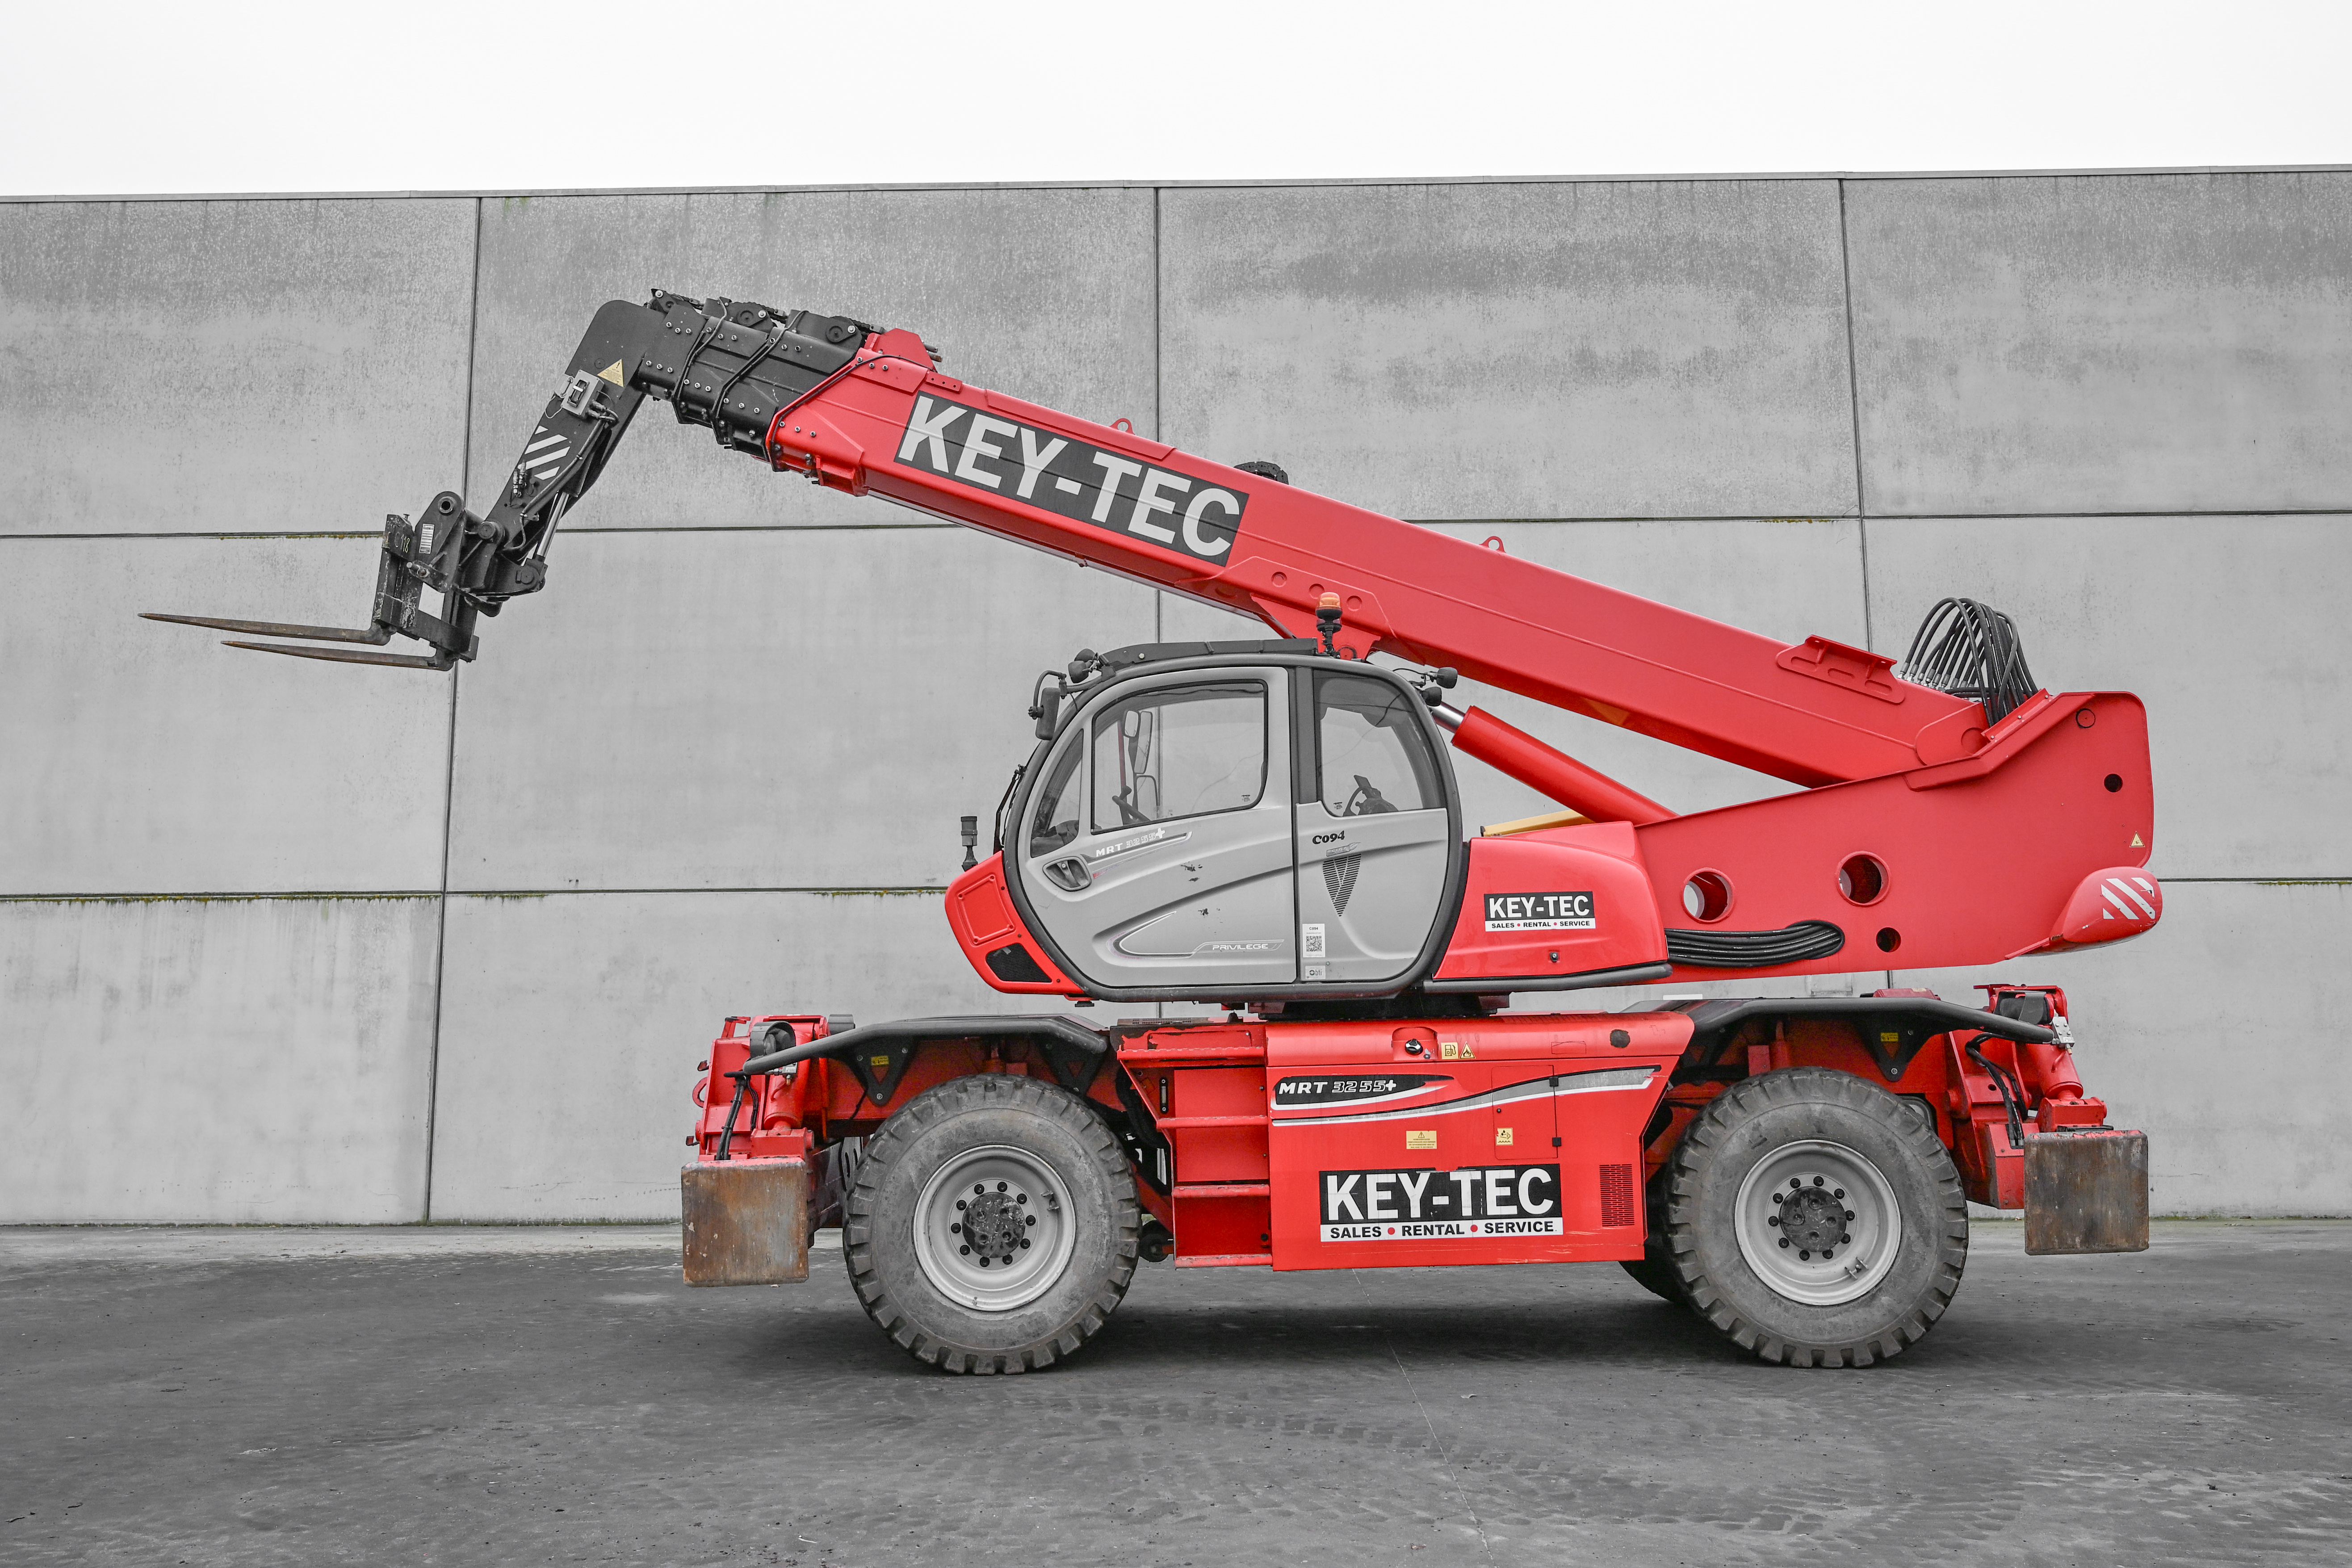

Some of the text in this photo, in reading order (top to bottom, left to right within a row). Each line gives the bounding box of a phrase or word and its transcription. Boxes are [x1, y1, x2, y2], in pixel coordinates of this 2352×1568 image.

[898, 395, 1240, 556] KEY-TEC
[1096, 828, 1165, 857] MRT 3255+
[1312, 830, 1345, 844] C094
[1489, 895, 1589, 918] KEY-TEC
[1279, 1079, 1396, 1094] MRT 3255+
[1327, 1168, 1554, 1220] KEY-TEC
[1330, 1226, 1381, 1238] SALES
[1402, 1224, 1464, 1236] RENTAL
